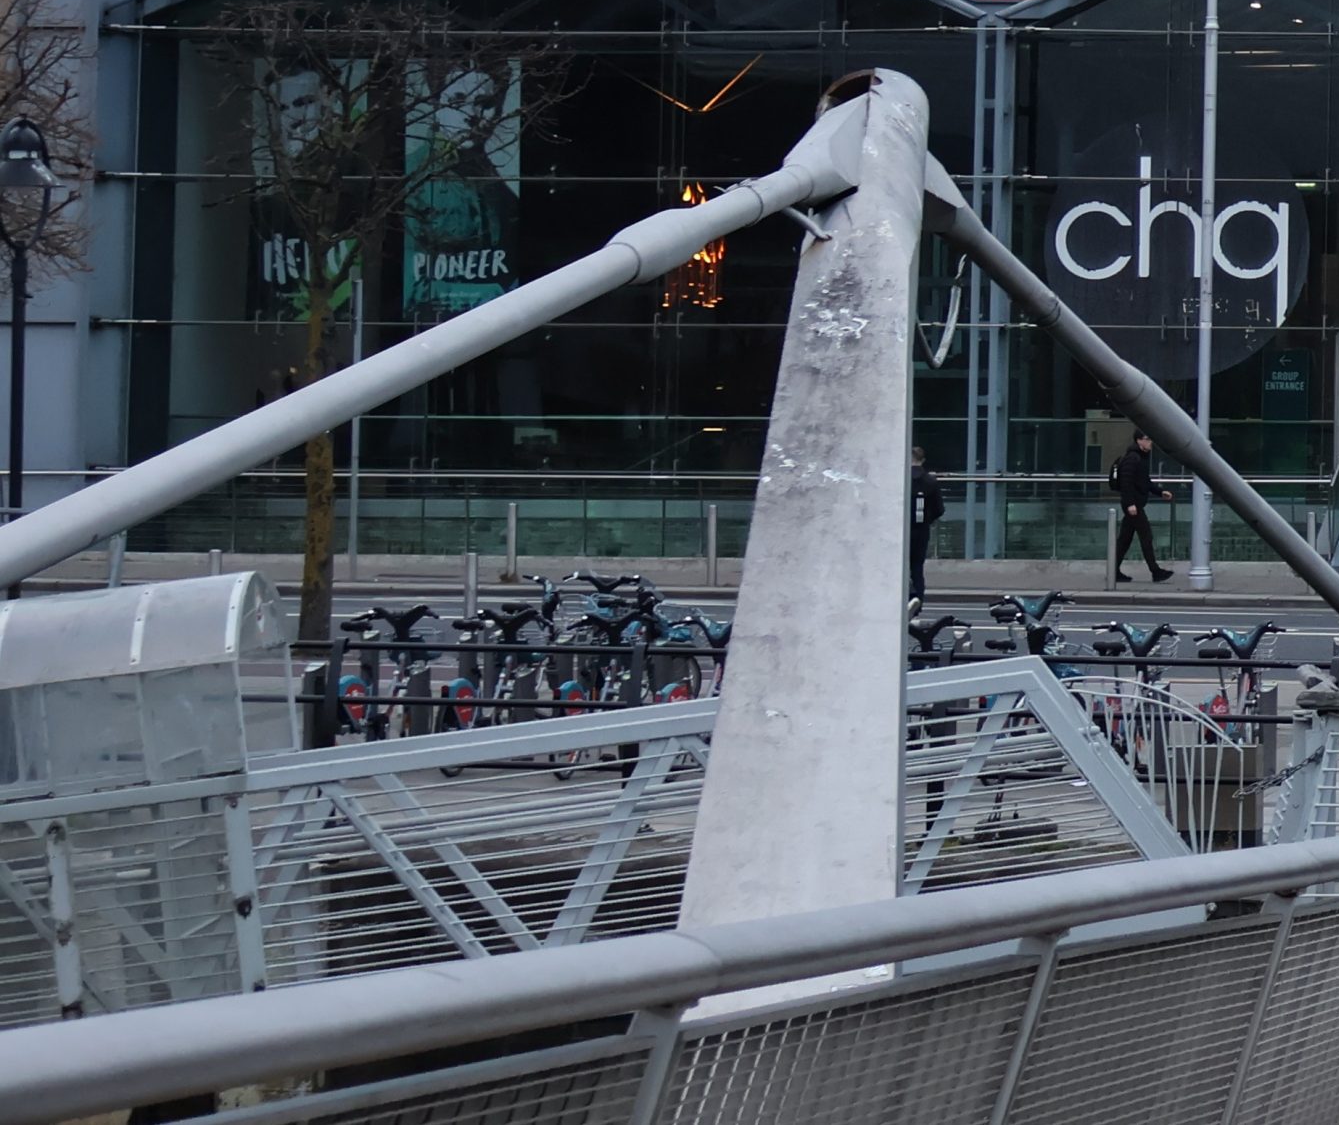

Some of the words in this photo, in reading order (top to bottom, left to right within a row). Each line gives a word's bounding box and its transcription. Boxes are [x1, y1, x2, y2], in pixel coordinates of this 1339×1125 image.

[1055, 156, 1289, 328] chq
[413, 249, 509, 281] PIONEER
[1265, 382, 1304, 391] ENTRANCE
[1272, 371, 1299, 381] GROUP
